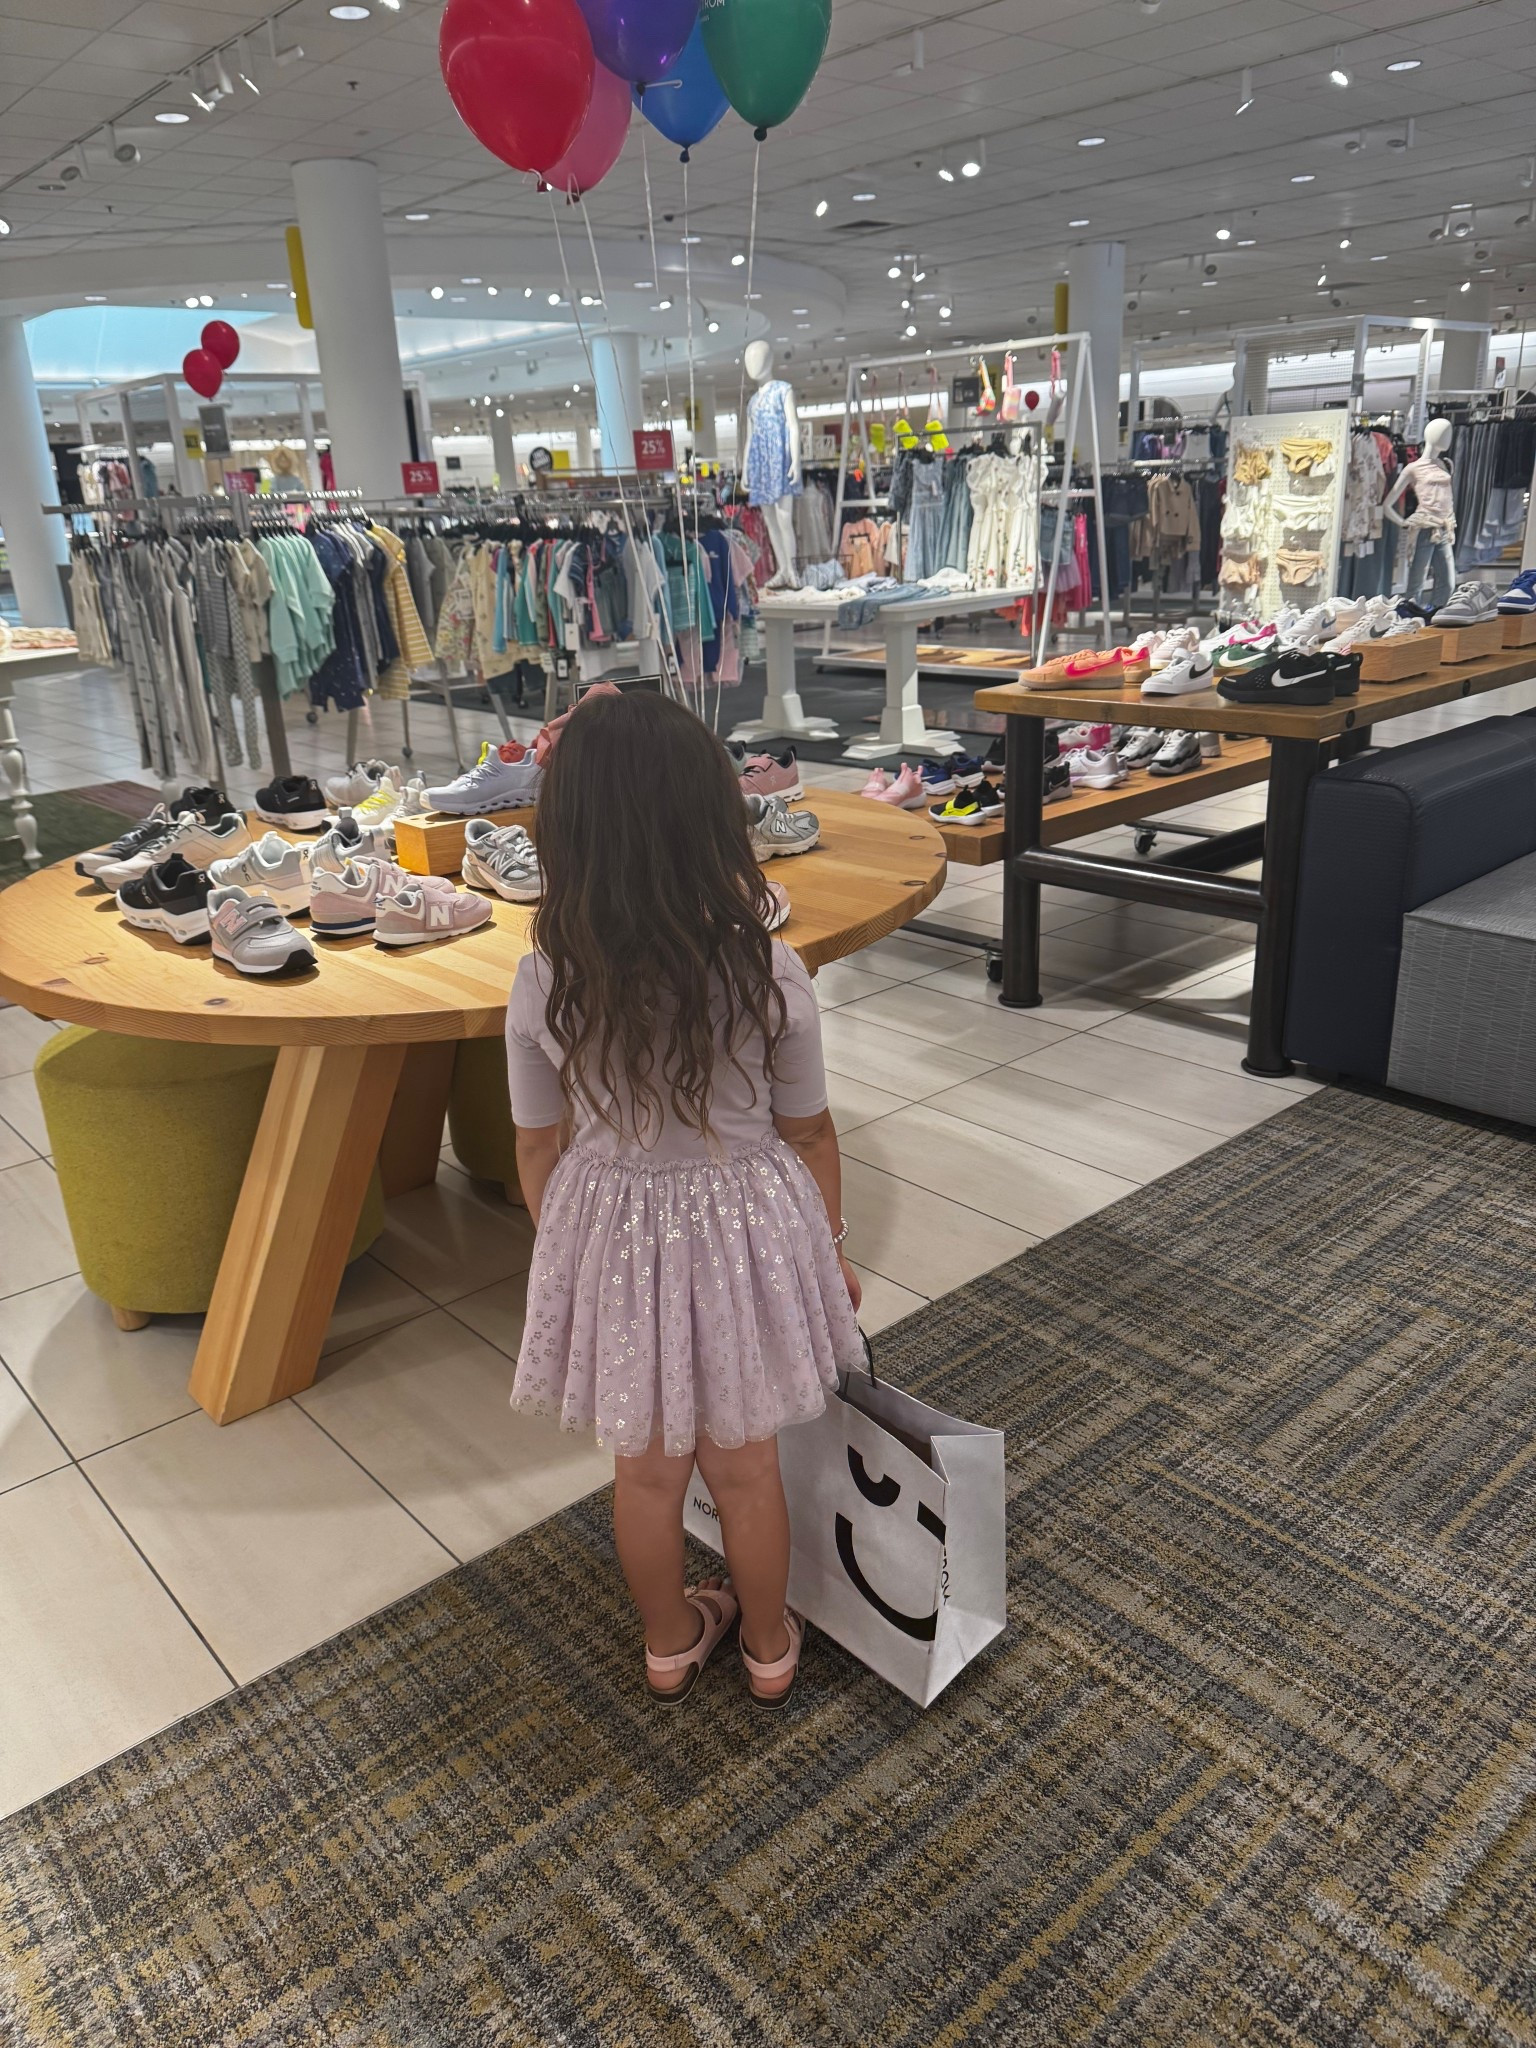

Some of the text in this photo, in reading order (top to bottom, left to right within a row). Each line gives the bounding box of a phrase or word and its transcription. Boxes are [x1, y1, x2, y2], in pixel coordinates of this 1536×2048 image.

[641, 439, 666, 455] 25%
[409, 470, 432, 482] 25%
[776, 820, 787, 833] N
[220, 908, 248, 935] N
[430, 905, 450, 927] N
